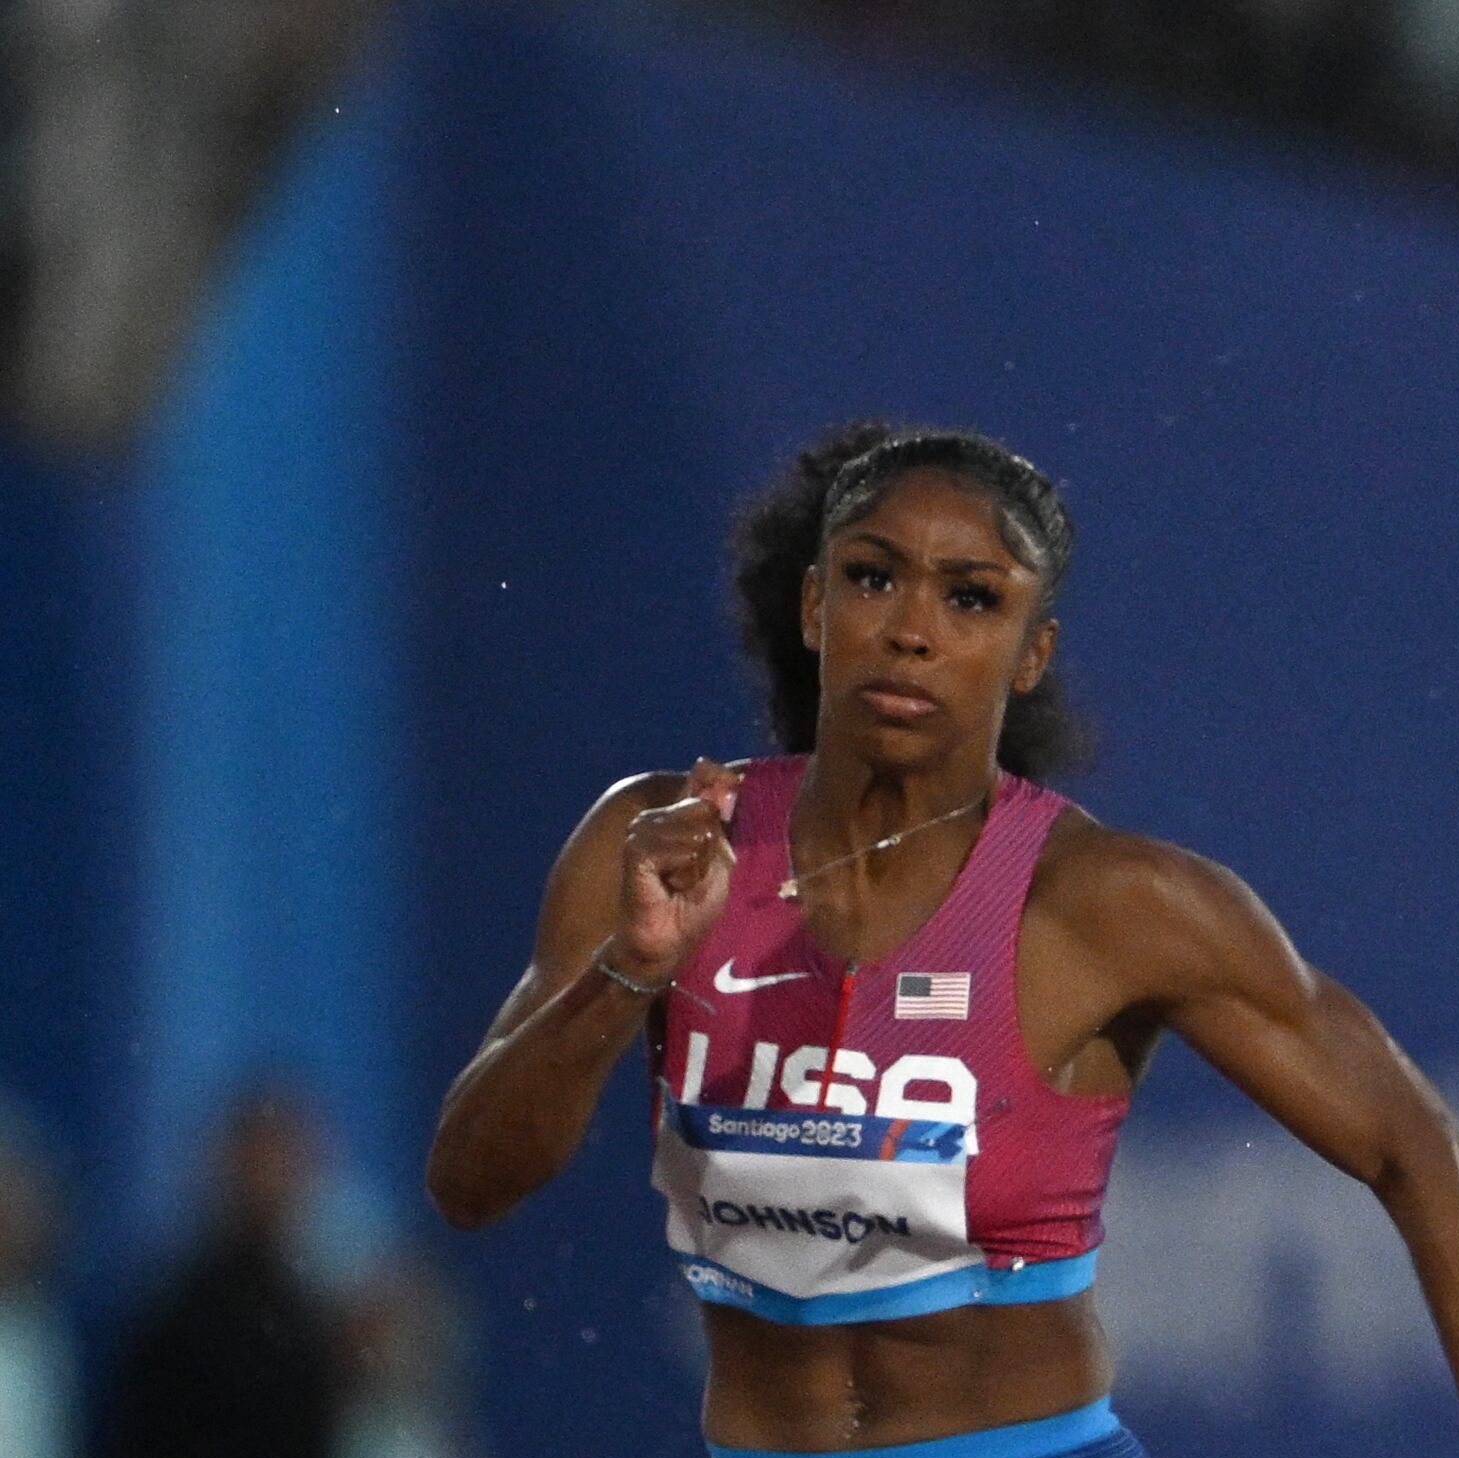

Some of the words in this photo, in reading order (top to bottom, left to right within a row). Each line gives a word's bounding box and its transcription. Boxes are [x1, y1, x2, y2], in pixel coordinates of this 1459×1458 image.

[681, 1031, 979, 1155] USA
[708, 1113, 800, 1143] Santiago
[800, 1119, 862, 1148] 2023
